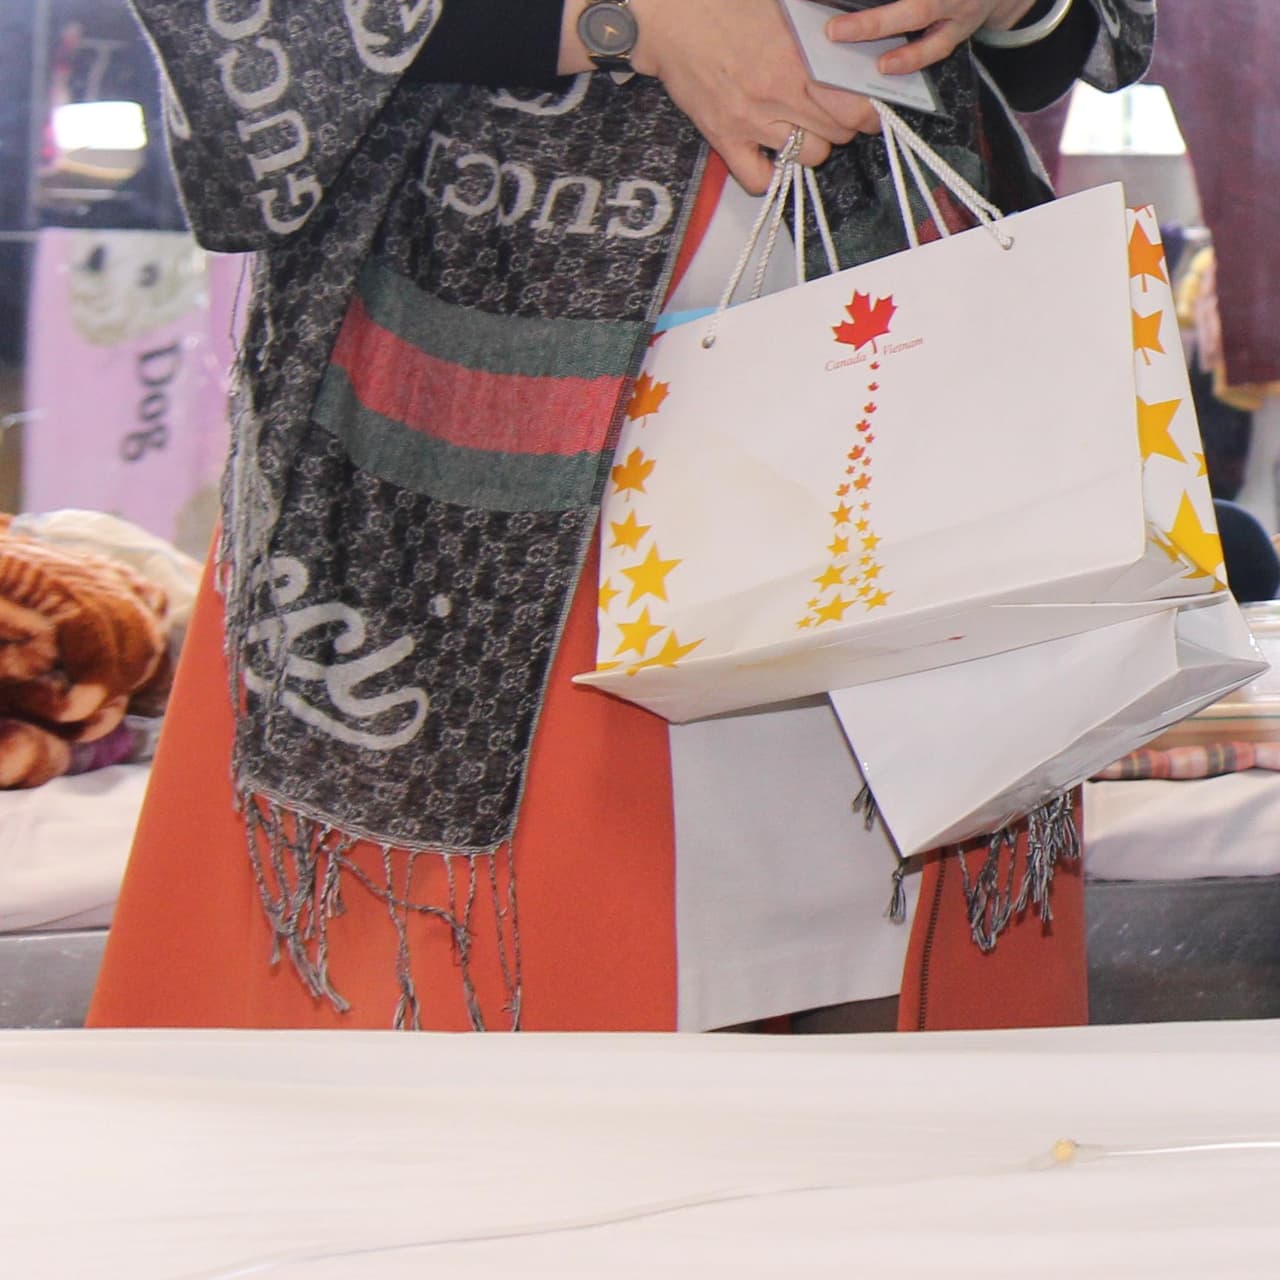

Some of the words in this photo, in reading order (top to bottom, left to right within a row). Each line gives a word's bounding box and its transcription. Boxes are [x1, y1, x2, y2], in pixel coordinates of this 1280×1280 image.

[418, 130, 674, 240] GUCCI
[824, 352, 868, 372] Canada
[882, 337, 925, 356] Vietnam
